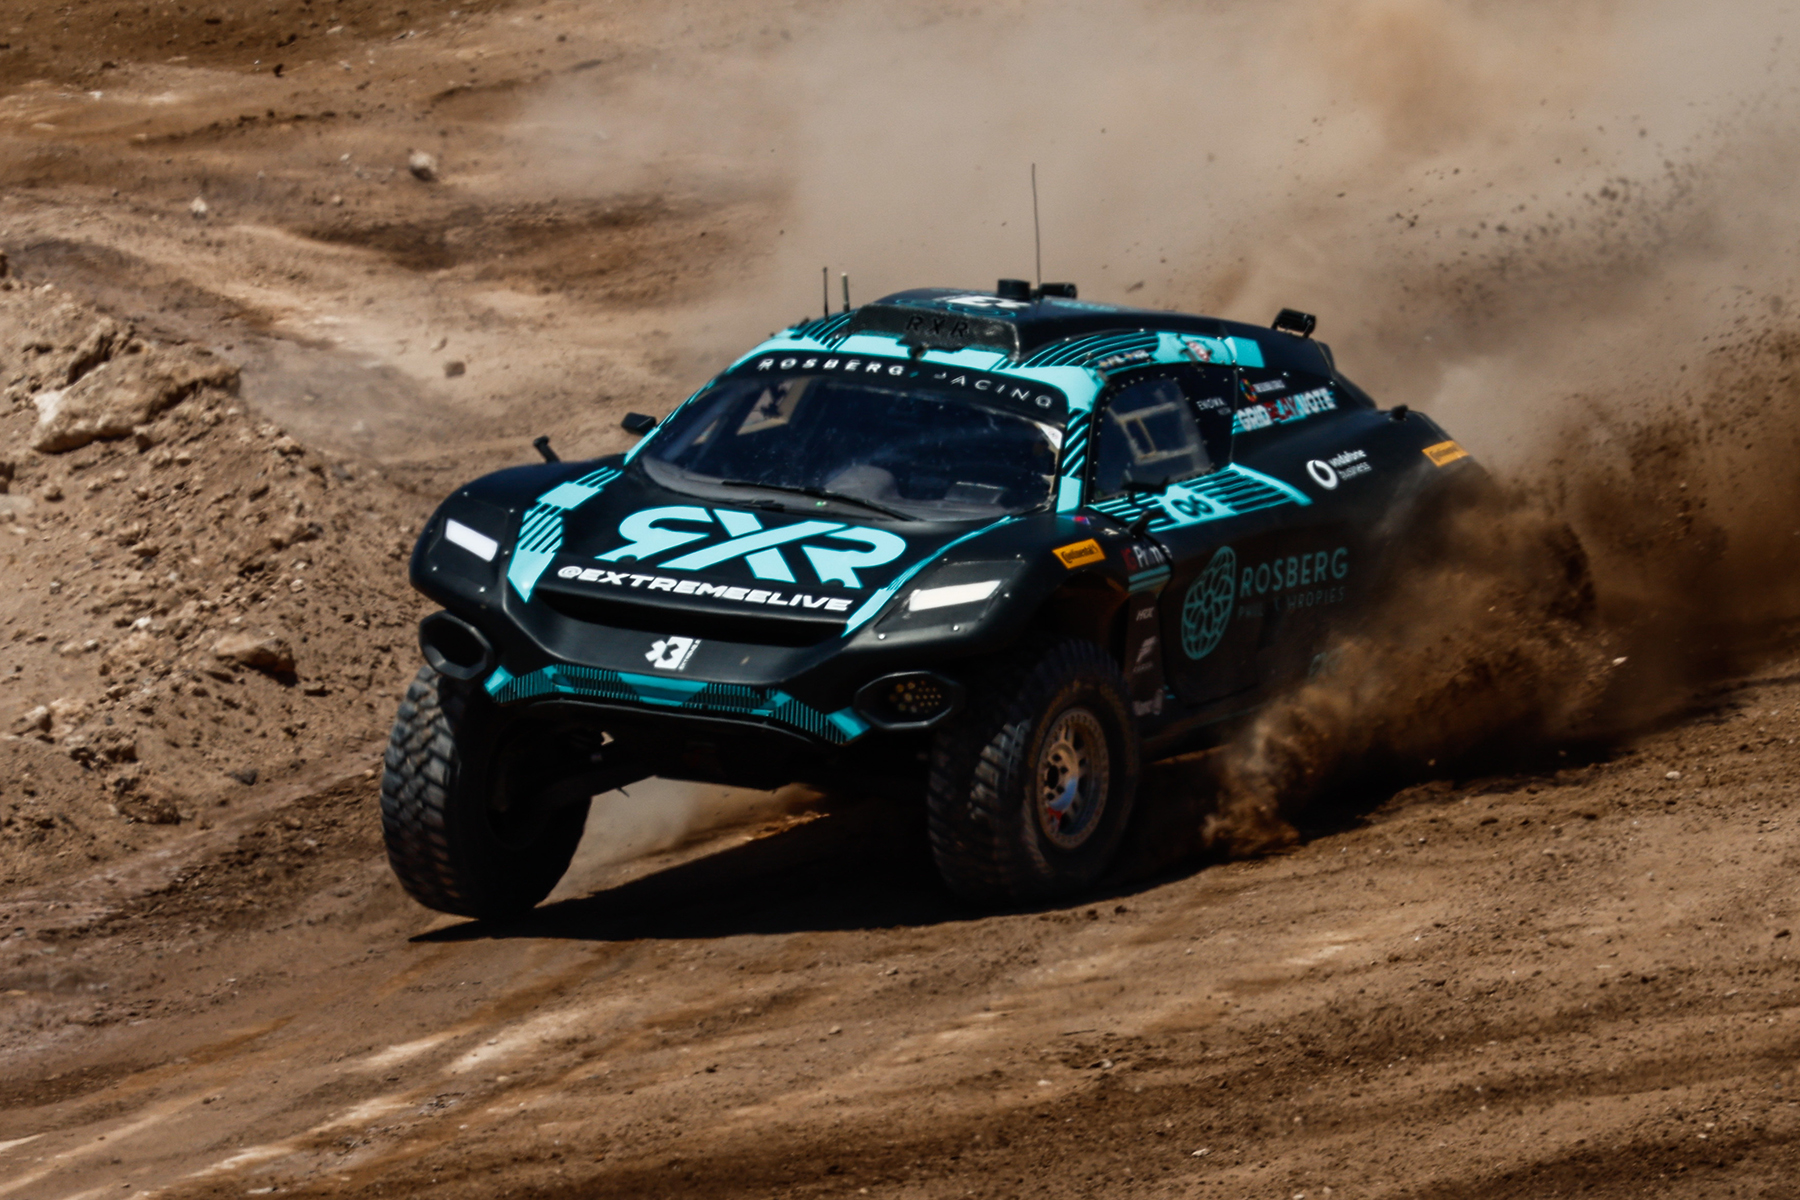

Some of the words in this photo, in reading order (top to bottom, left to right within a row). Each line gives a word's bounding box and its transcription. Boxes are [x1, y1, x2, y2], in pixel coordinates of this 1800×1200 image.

[907, 316, 968, 337] RXR
[757, 357, 906, 376] ROSBERG
[934, 371, 1054, 409] ACING
[557, 565, 854, 612] @EXTREMEELIVE
[1239, 546, 1349, 598] ROSBERG
